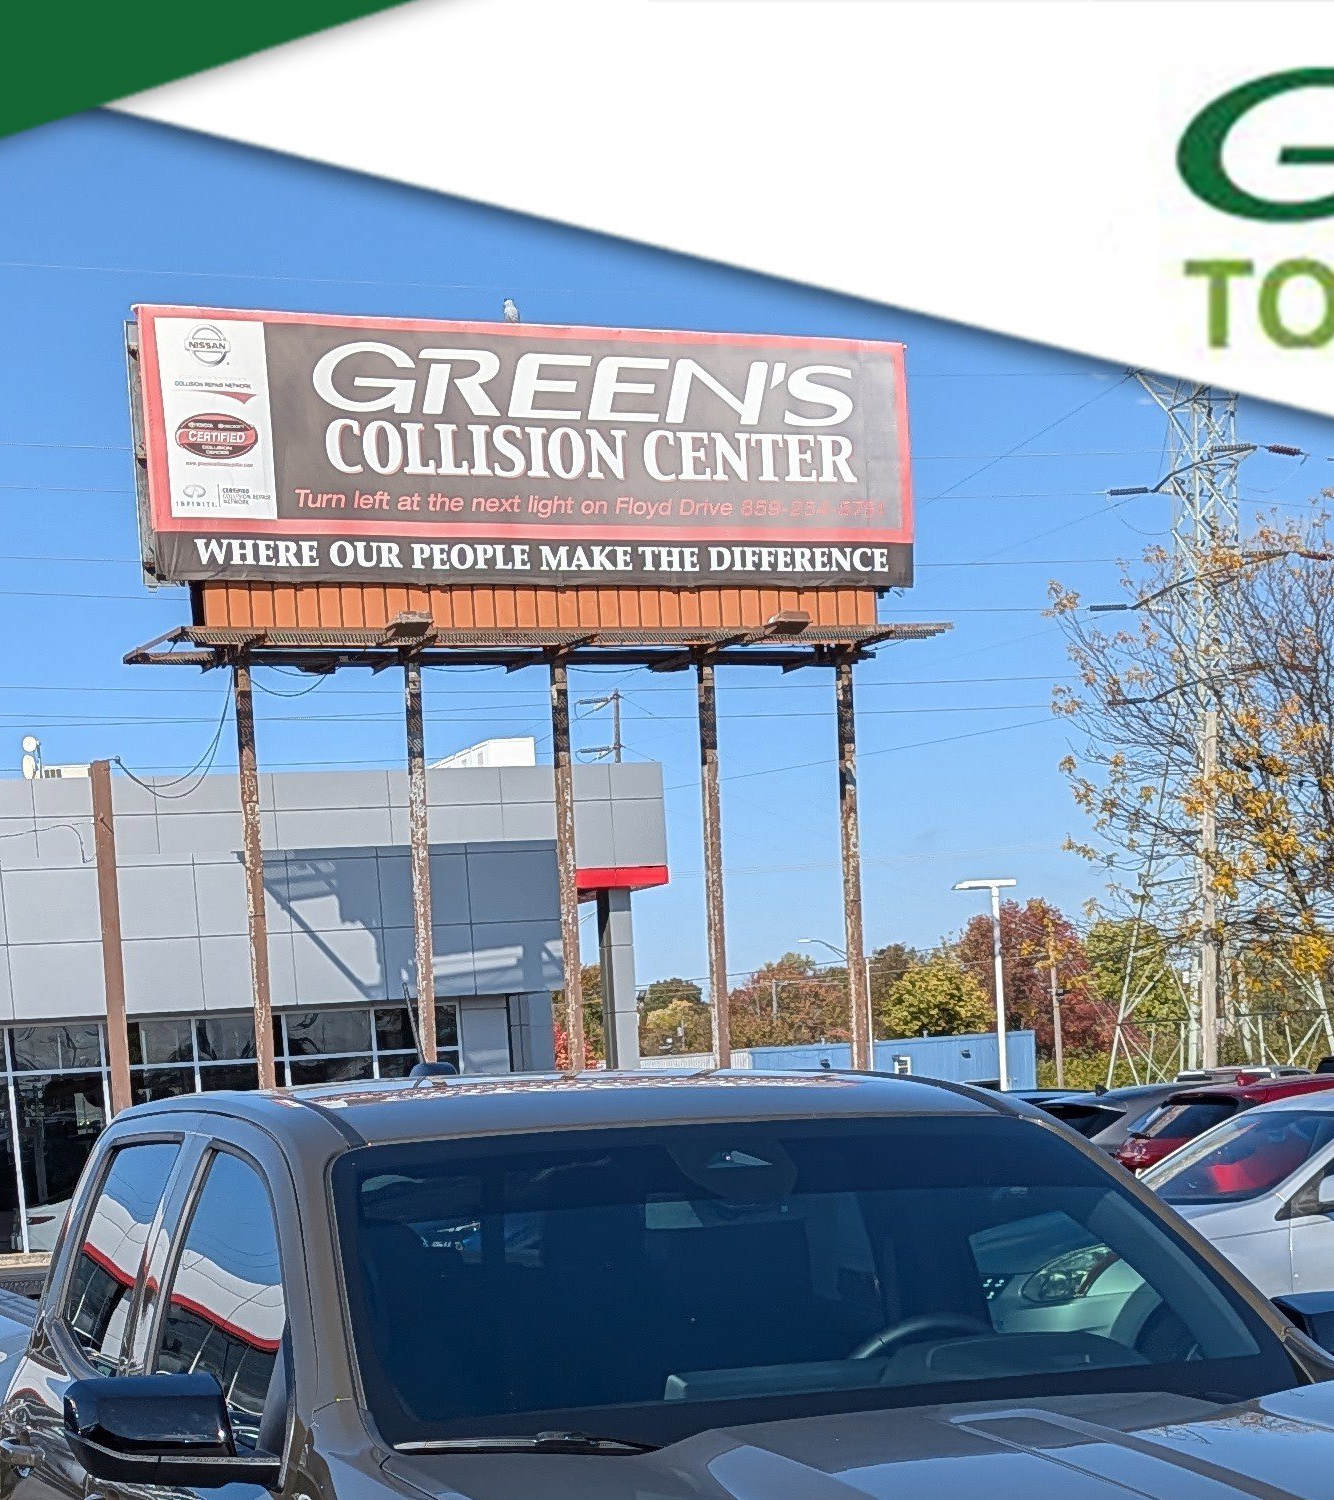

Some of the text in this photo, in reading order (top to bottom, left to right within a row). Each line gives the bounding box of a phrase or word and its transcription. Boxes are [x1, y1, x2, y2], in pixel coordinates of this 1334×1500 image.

[188, 340, 226, 350] NISSAN
[312, 341, 854, 427] GREEN'S
[188, 430, 246, 443] CERTIFIED
[325, 418, 858, 483] COLLISION CENTER
[294, 488, 346, 509] Turn
[353, 490, 391, 510] left
[397, 492, 421, 512] at
[427, 493, 465, 513] the
[471, 494, 521, 514] next
[527, 495, 575, 519] light
[580, 500, 608, 515] on
[615, 496, 672, 520] Floyd
[678, 498, 733, 517] Drive
[194, 537, 889, 573] WHERE OUR PEOPLE MAKE THE DIFFERENCE
